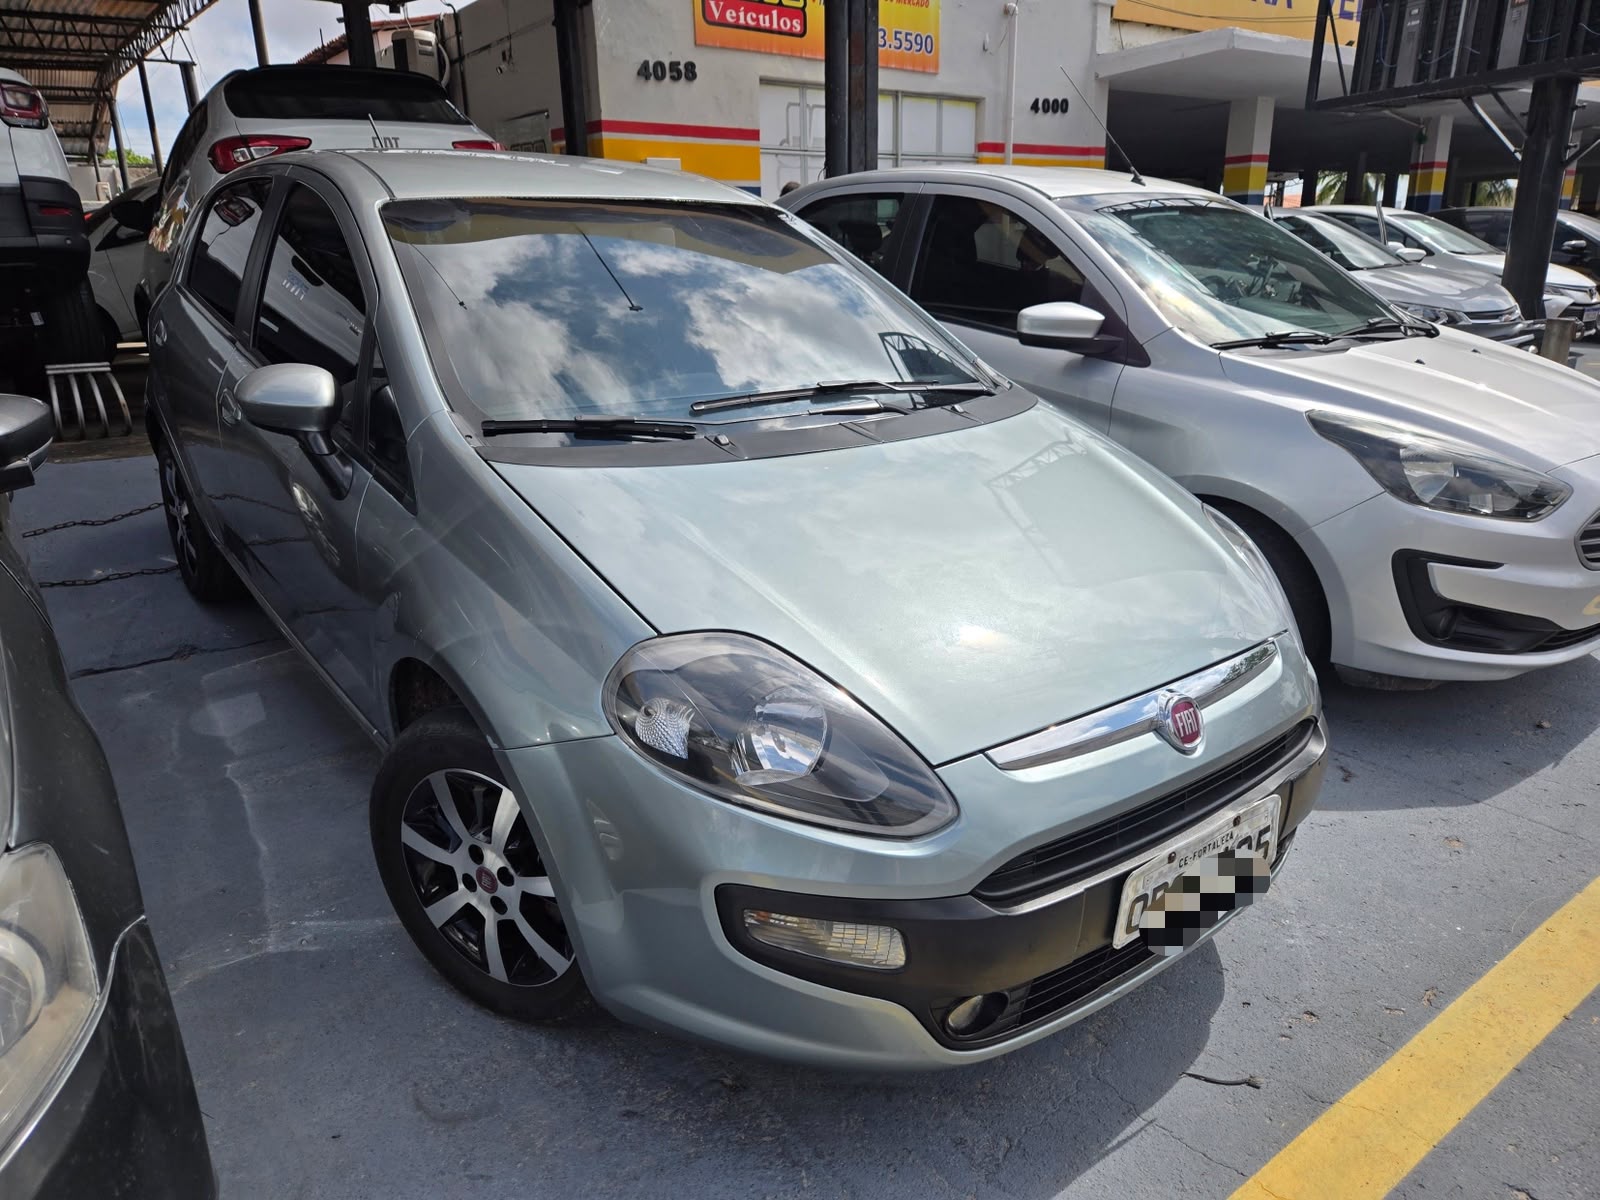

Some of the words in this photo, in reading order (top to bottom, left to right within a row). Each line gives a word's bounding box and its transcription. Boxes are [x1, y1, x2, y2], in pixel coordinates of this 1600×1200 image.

[709, 1, 801, 32] Veículos
[637, 59, 697, 82] 4058
[1030, 97, 1069, 114] 4000
[1175, 707, 1198, 737] FIAT
